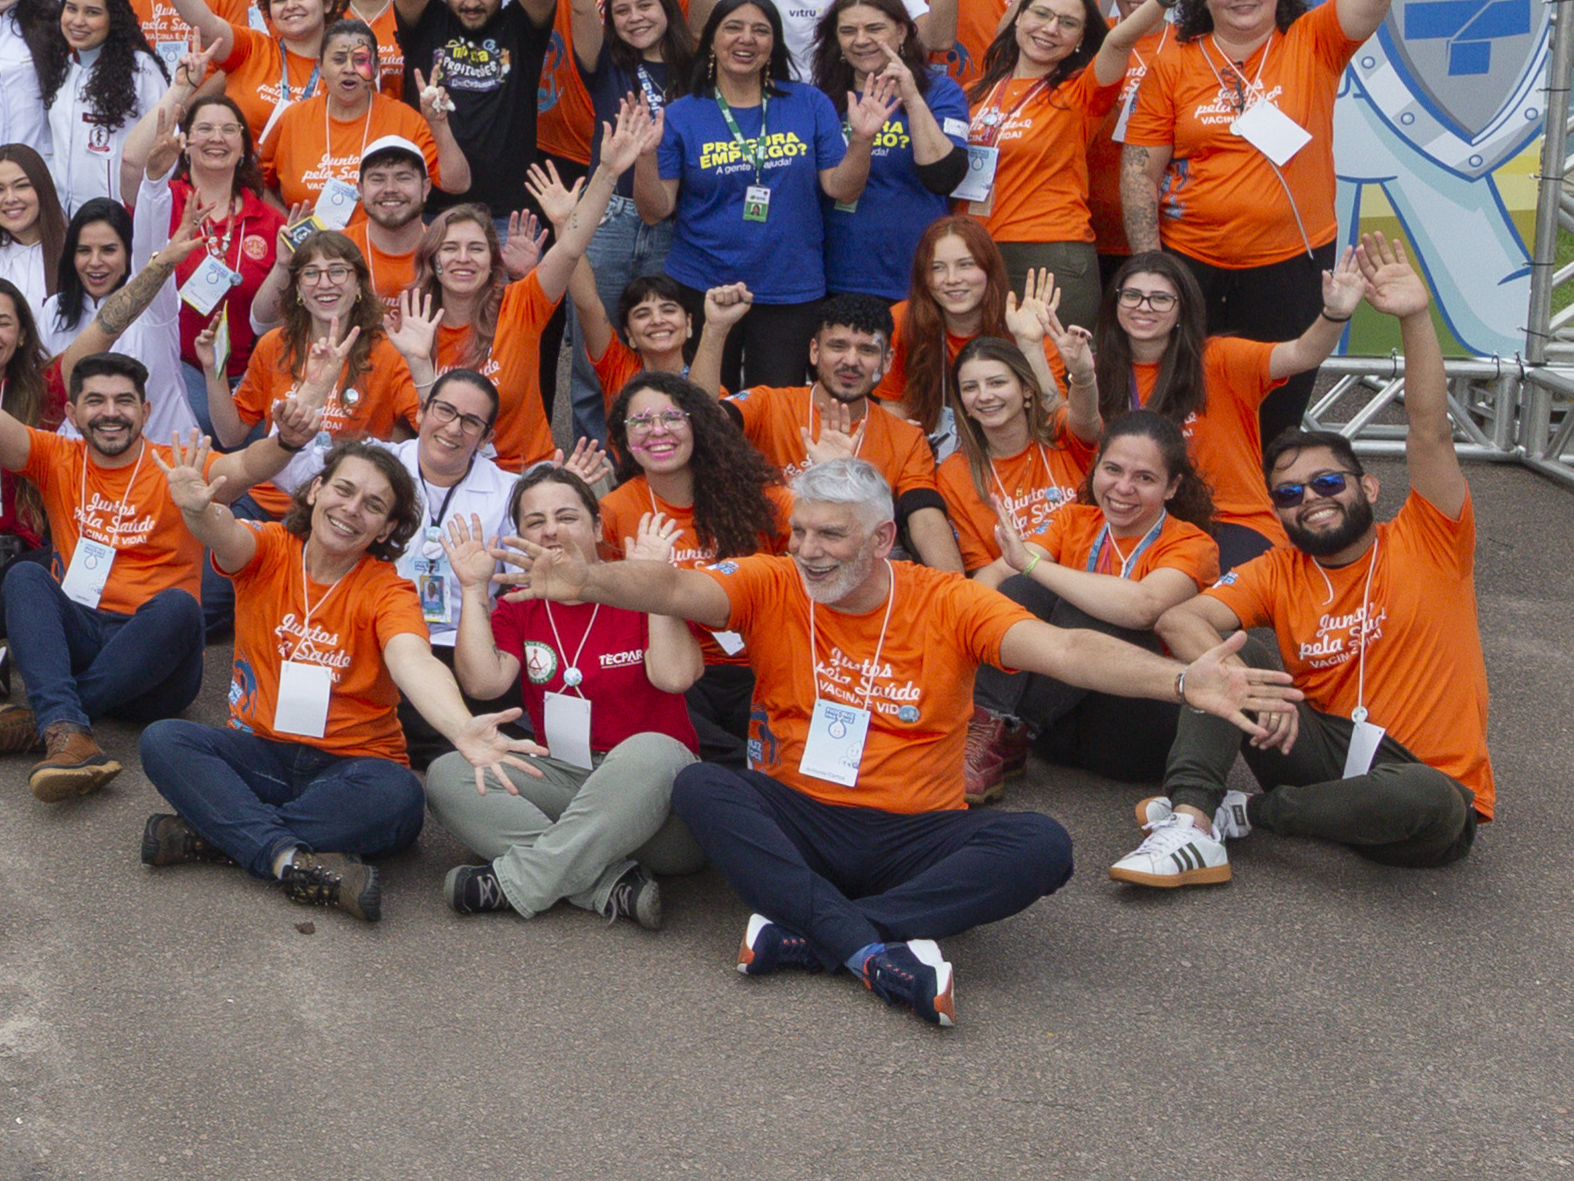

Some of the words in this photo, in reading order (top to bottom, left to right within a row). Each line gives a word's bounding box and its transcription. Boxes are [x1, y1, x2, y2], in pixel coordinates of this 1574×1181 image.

[153, 4, 179, 19] Jun
[789, 9, 816, 18] vitru
[1202, 115, 1239, 126] VACIN
[318, 154, 361, 169] Junto
[725, 161, 752, 176] gente
[86, 492, 137, 517] Juntos
[1005, 487, 1048, 513] Junto
[110, 505, 156, 533] Saúde
[119, 534, 148, 546] VIDA!
[669, 546, 714, 568] Junto
[283, 613, 339, 647] Juntos
[1299, 635, 1343, 660] pela
[856, 671, 921, 699] Saúde
[876, 700, 900, 714] VID
